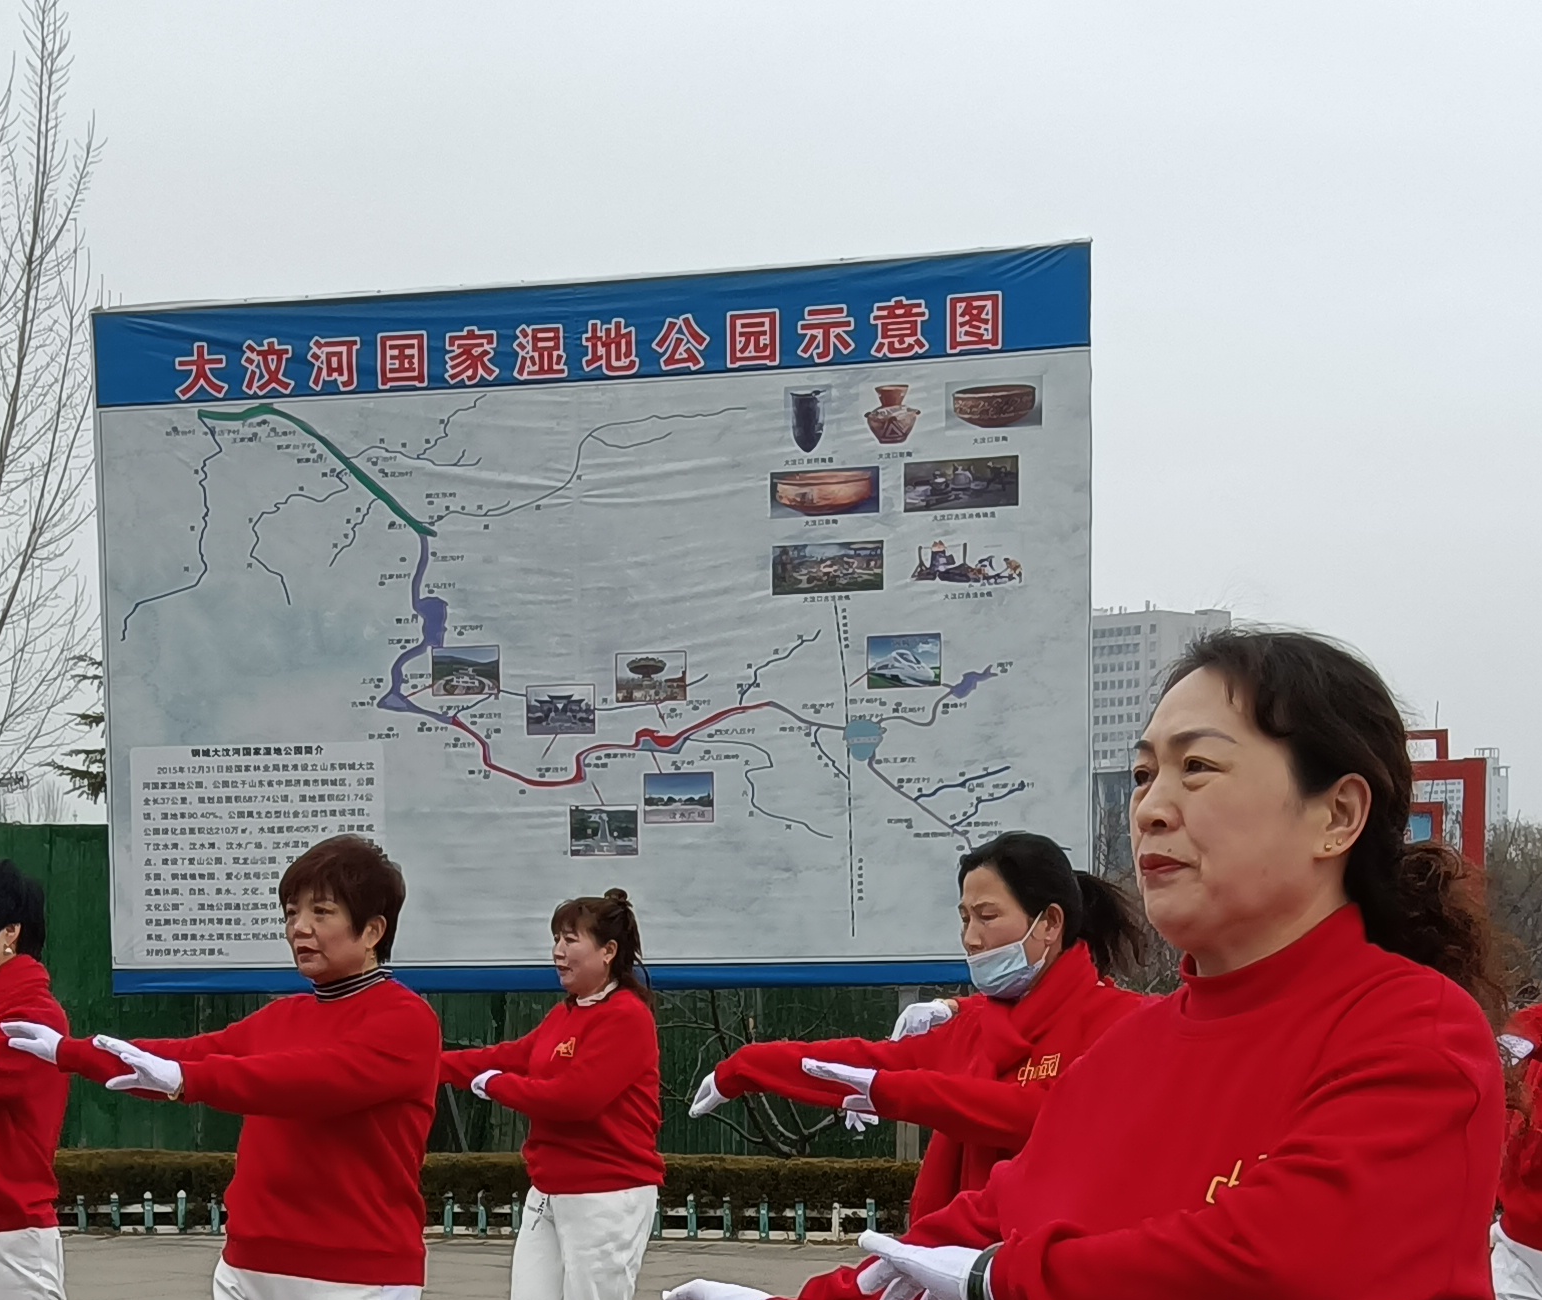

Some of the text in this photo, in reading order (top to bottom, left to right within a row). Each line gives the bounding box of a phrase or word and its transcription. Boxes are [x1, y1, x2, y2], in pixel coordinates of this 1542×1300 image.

[174, 290, 1005, 400] 大汶河国家湿地公园示意图
